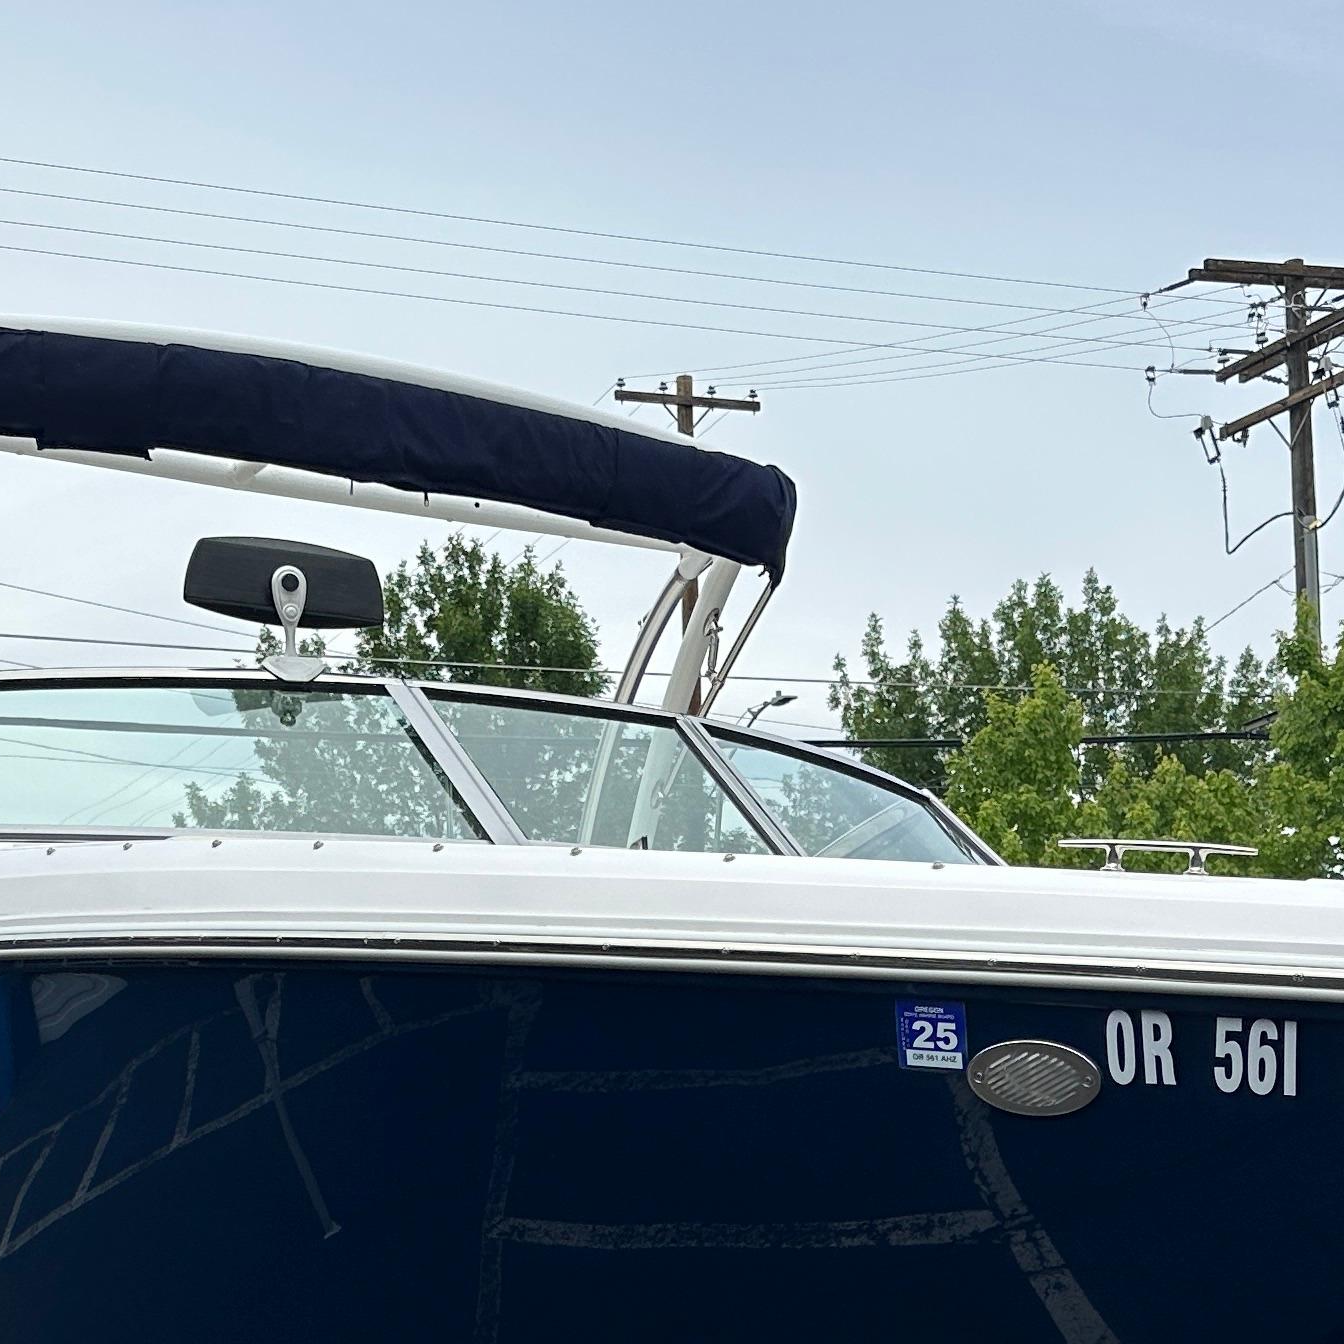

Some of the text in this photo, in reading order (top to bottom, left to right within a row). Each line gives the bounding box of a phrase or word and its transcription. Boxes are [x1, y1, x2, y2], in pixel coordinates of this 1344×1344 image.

[912, 1020, 958, 1051] 25
[1106, 1009, 1177, 1086] OR
[1214, 1017, 1297, 1097] 561
